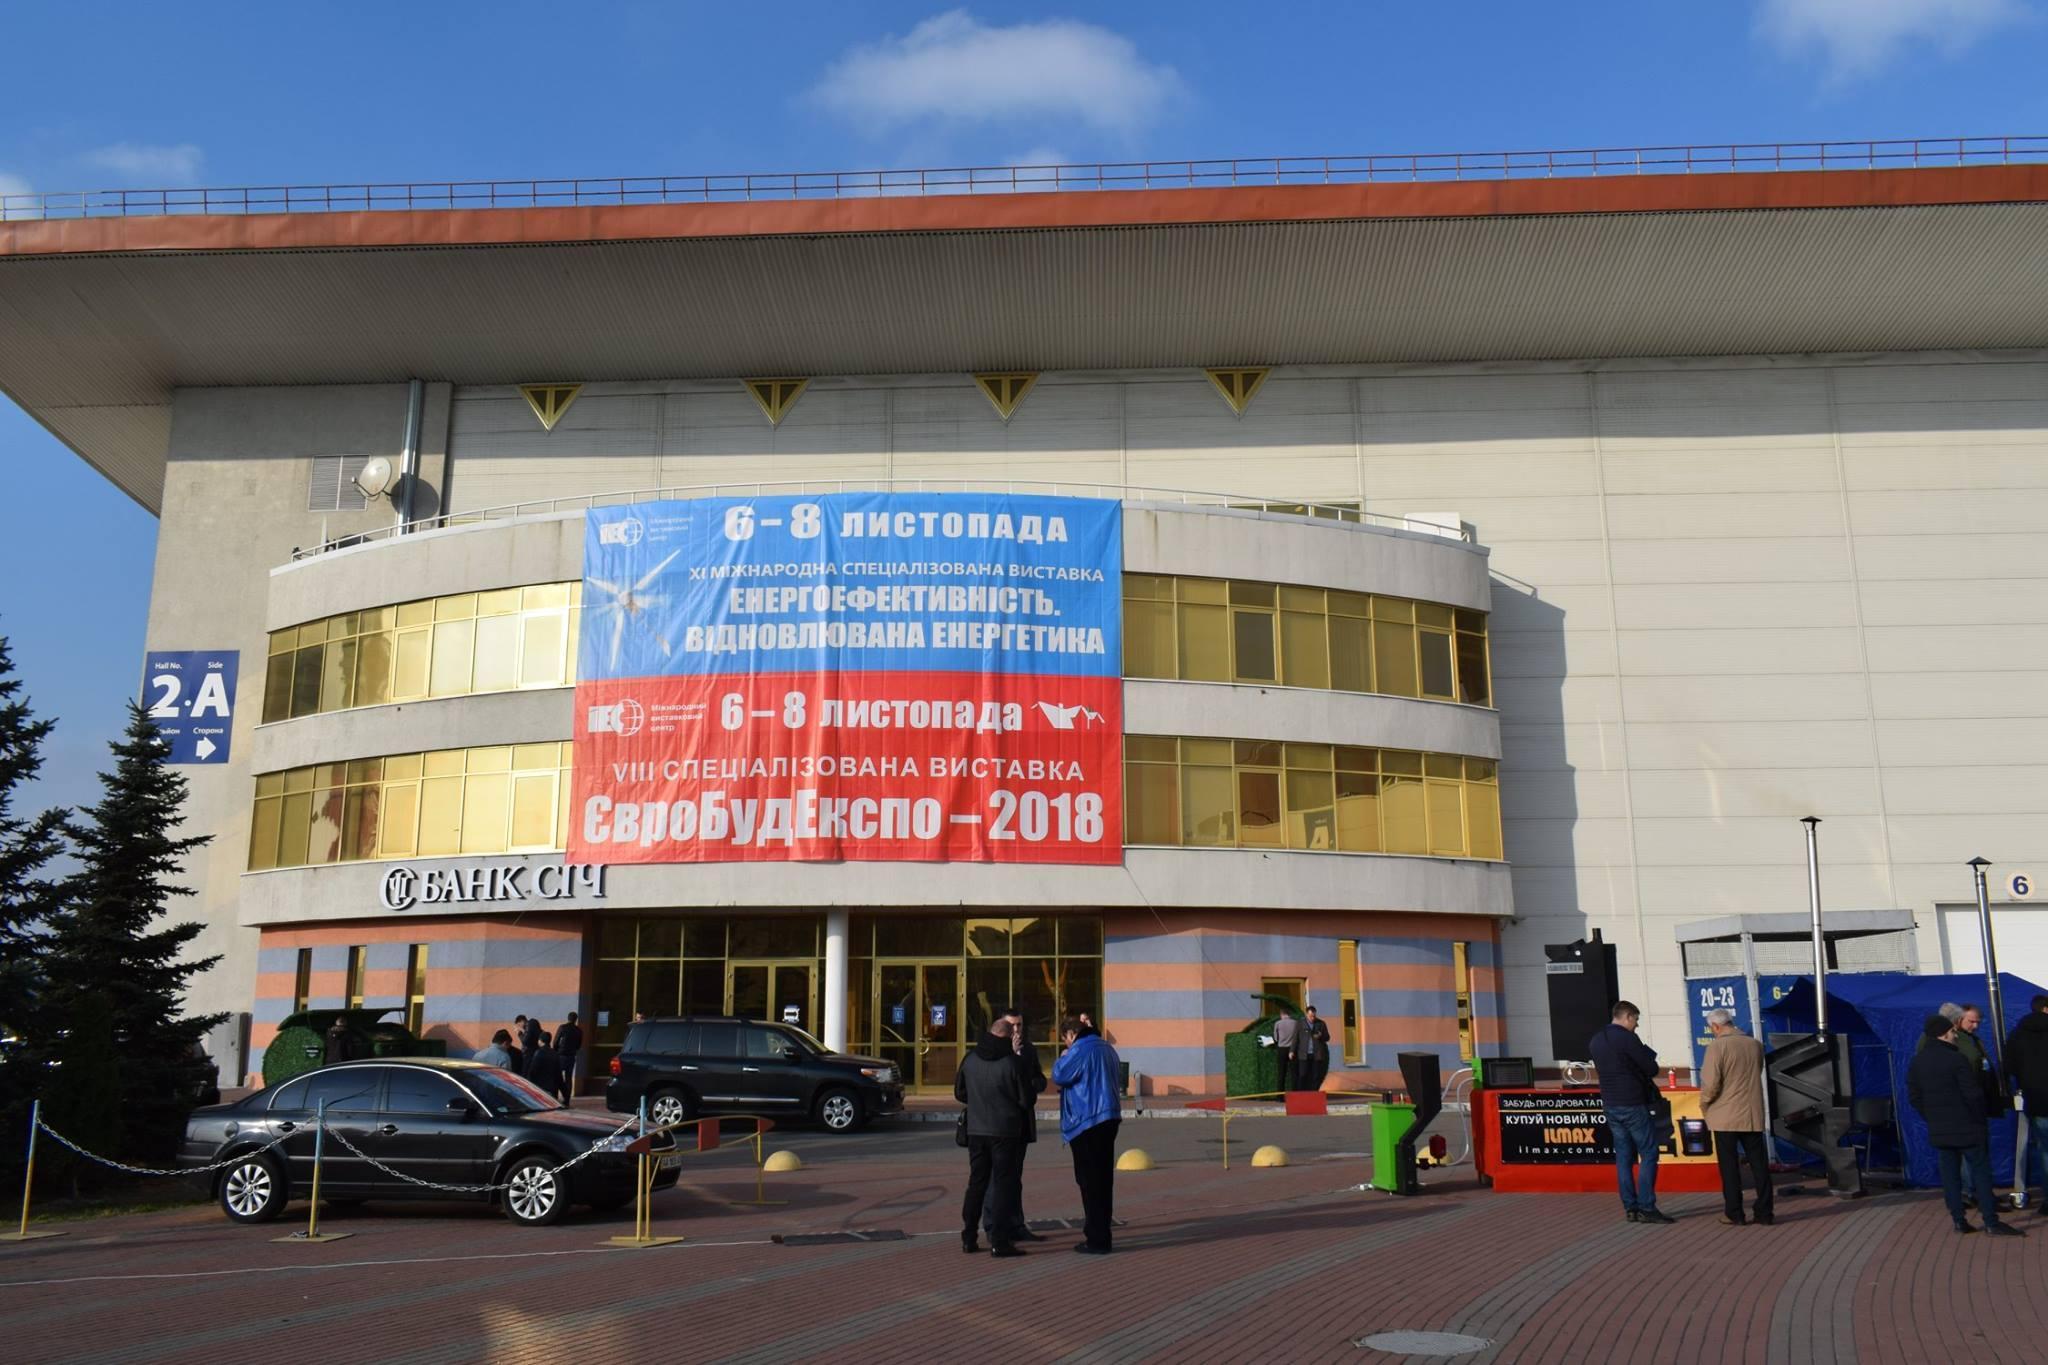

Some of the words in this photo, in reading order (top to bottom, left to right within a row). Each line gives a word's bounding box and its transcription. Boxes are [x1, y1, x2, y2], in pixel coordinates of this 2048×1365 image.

[840, 511, 1068, 545] ЛИСТОПАДА
[710, 562, 837, 580] МІЖНАРОДНА
[842, 561, 1004, 578] СПЕЦІАЛІЗОВАНА
[1009, 565, 1104, 582] ВИСТАВКА
[729, 584, 1061, 616] ЕНЕРГОЕФЕКТИВНІСТЬ.
[685, 621, 925, 655] ВІДНОВЛЮВАНА
[932, 622, 1105, 655] ЕНЕРГЕТИКА
[208, 661, 223, 669] Side
[819, 699, 1023, 735] листопада
[192, 727, 224, 736] Сторона
[613, 761, 654, 783] VIII
[663, 756, 920, 781] СПЕЦІАЛІЗОВАНА
[930, 757, 1084, 781] ВИСТАВКА
[421, 866, 527, 903] БАНК
[531, 864, 605, 899] СІЧ
[2012, 875, 2029, 895] 6
[1503, 1099, 1535, 1108] ЗАБУДЬ
[1536, 1099, 1554, 1108] ПРО
[1555, 1098, 1584, 1108] ДРОВА
[1585, 1098, 1596, 1107] ТА
[1506, 1113, 1543, 1124] КУПУЙ
[1546, 1113, 1588, 1124] НОВИЙ
[1544, 1127, 1596, 1144] ILMAX
